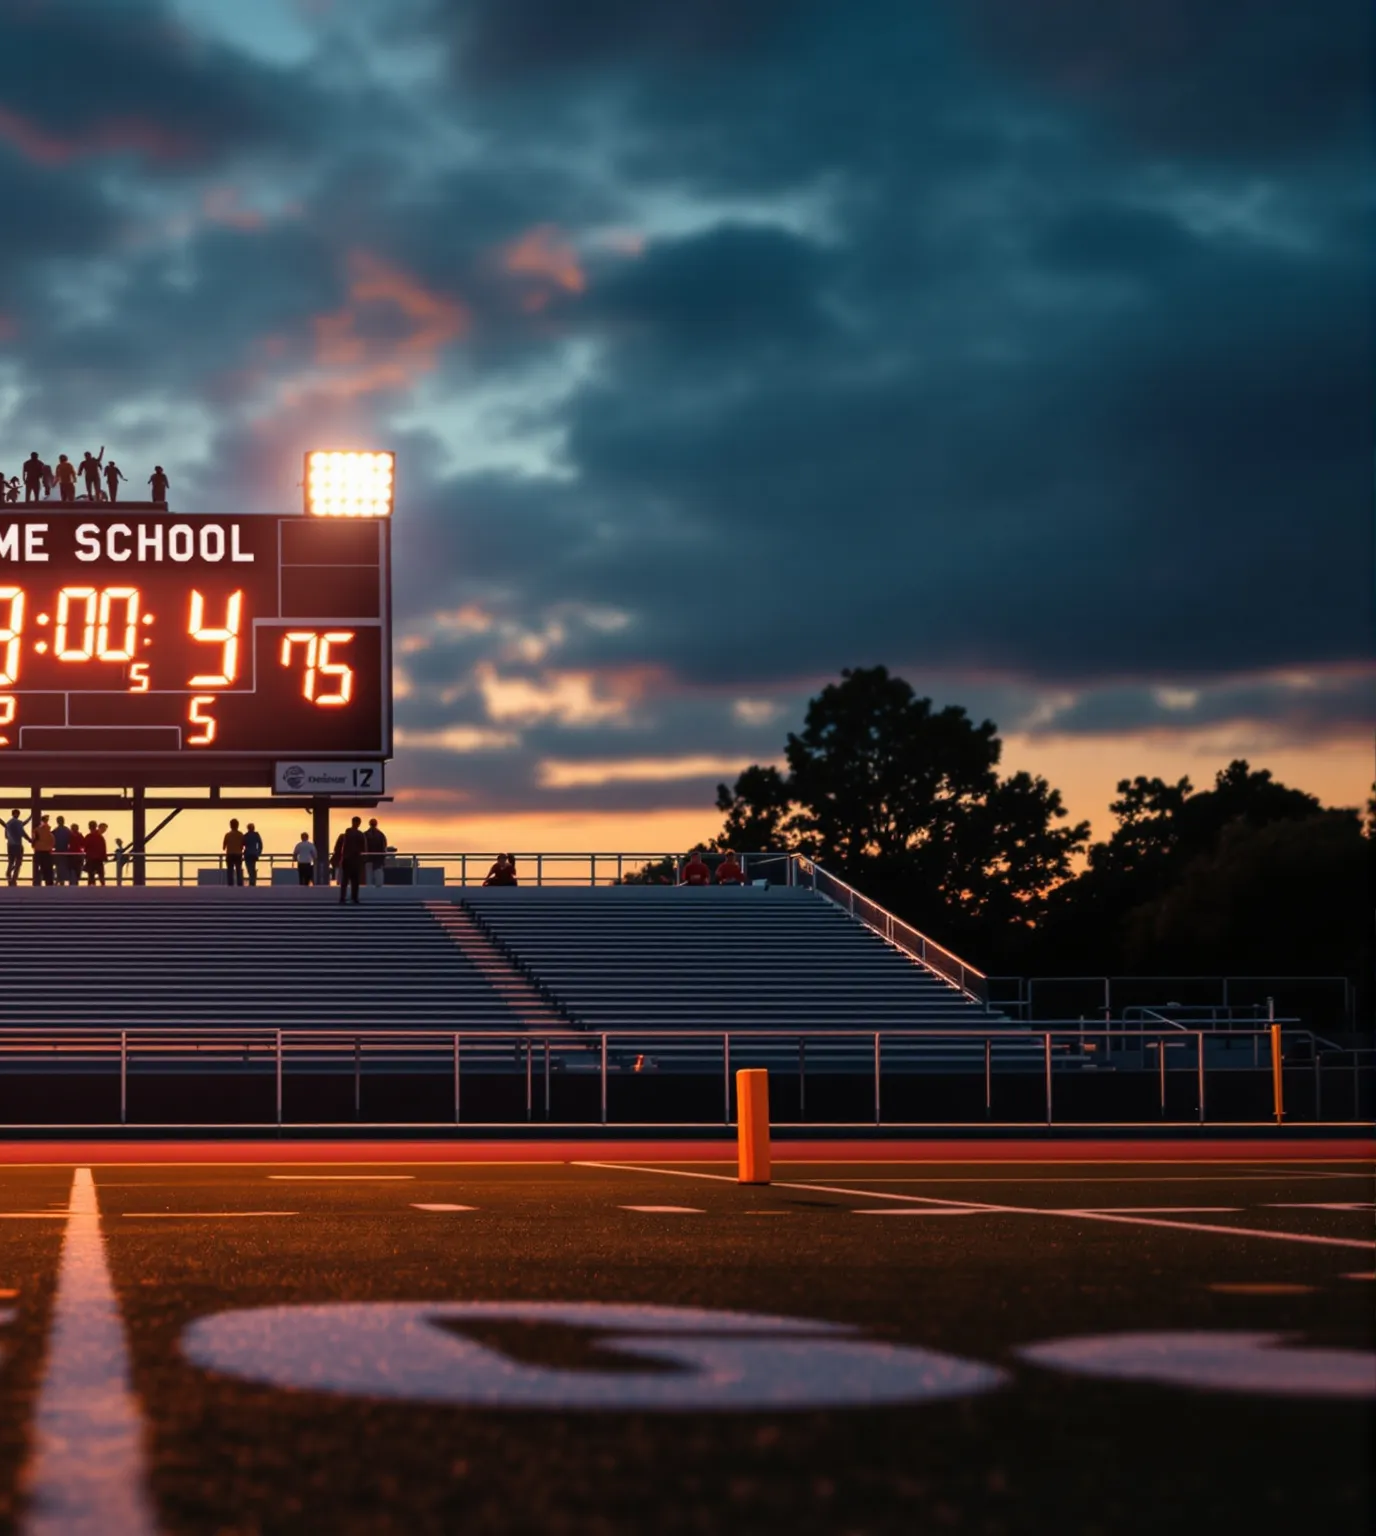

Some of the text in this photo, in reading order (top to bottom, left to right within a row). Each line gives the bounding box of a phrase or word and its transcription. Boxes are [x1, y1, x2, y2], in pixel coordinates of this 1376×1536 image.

[74, 523, 256, 562] SCHOOL
[128, 662, 150, 692] 5
[280, 632, 356, 706] 75
[187, 695, 217, 745] 5
